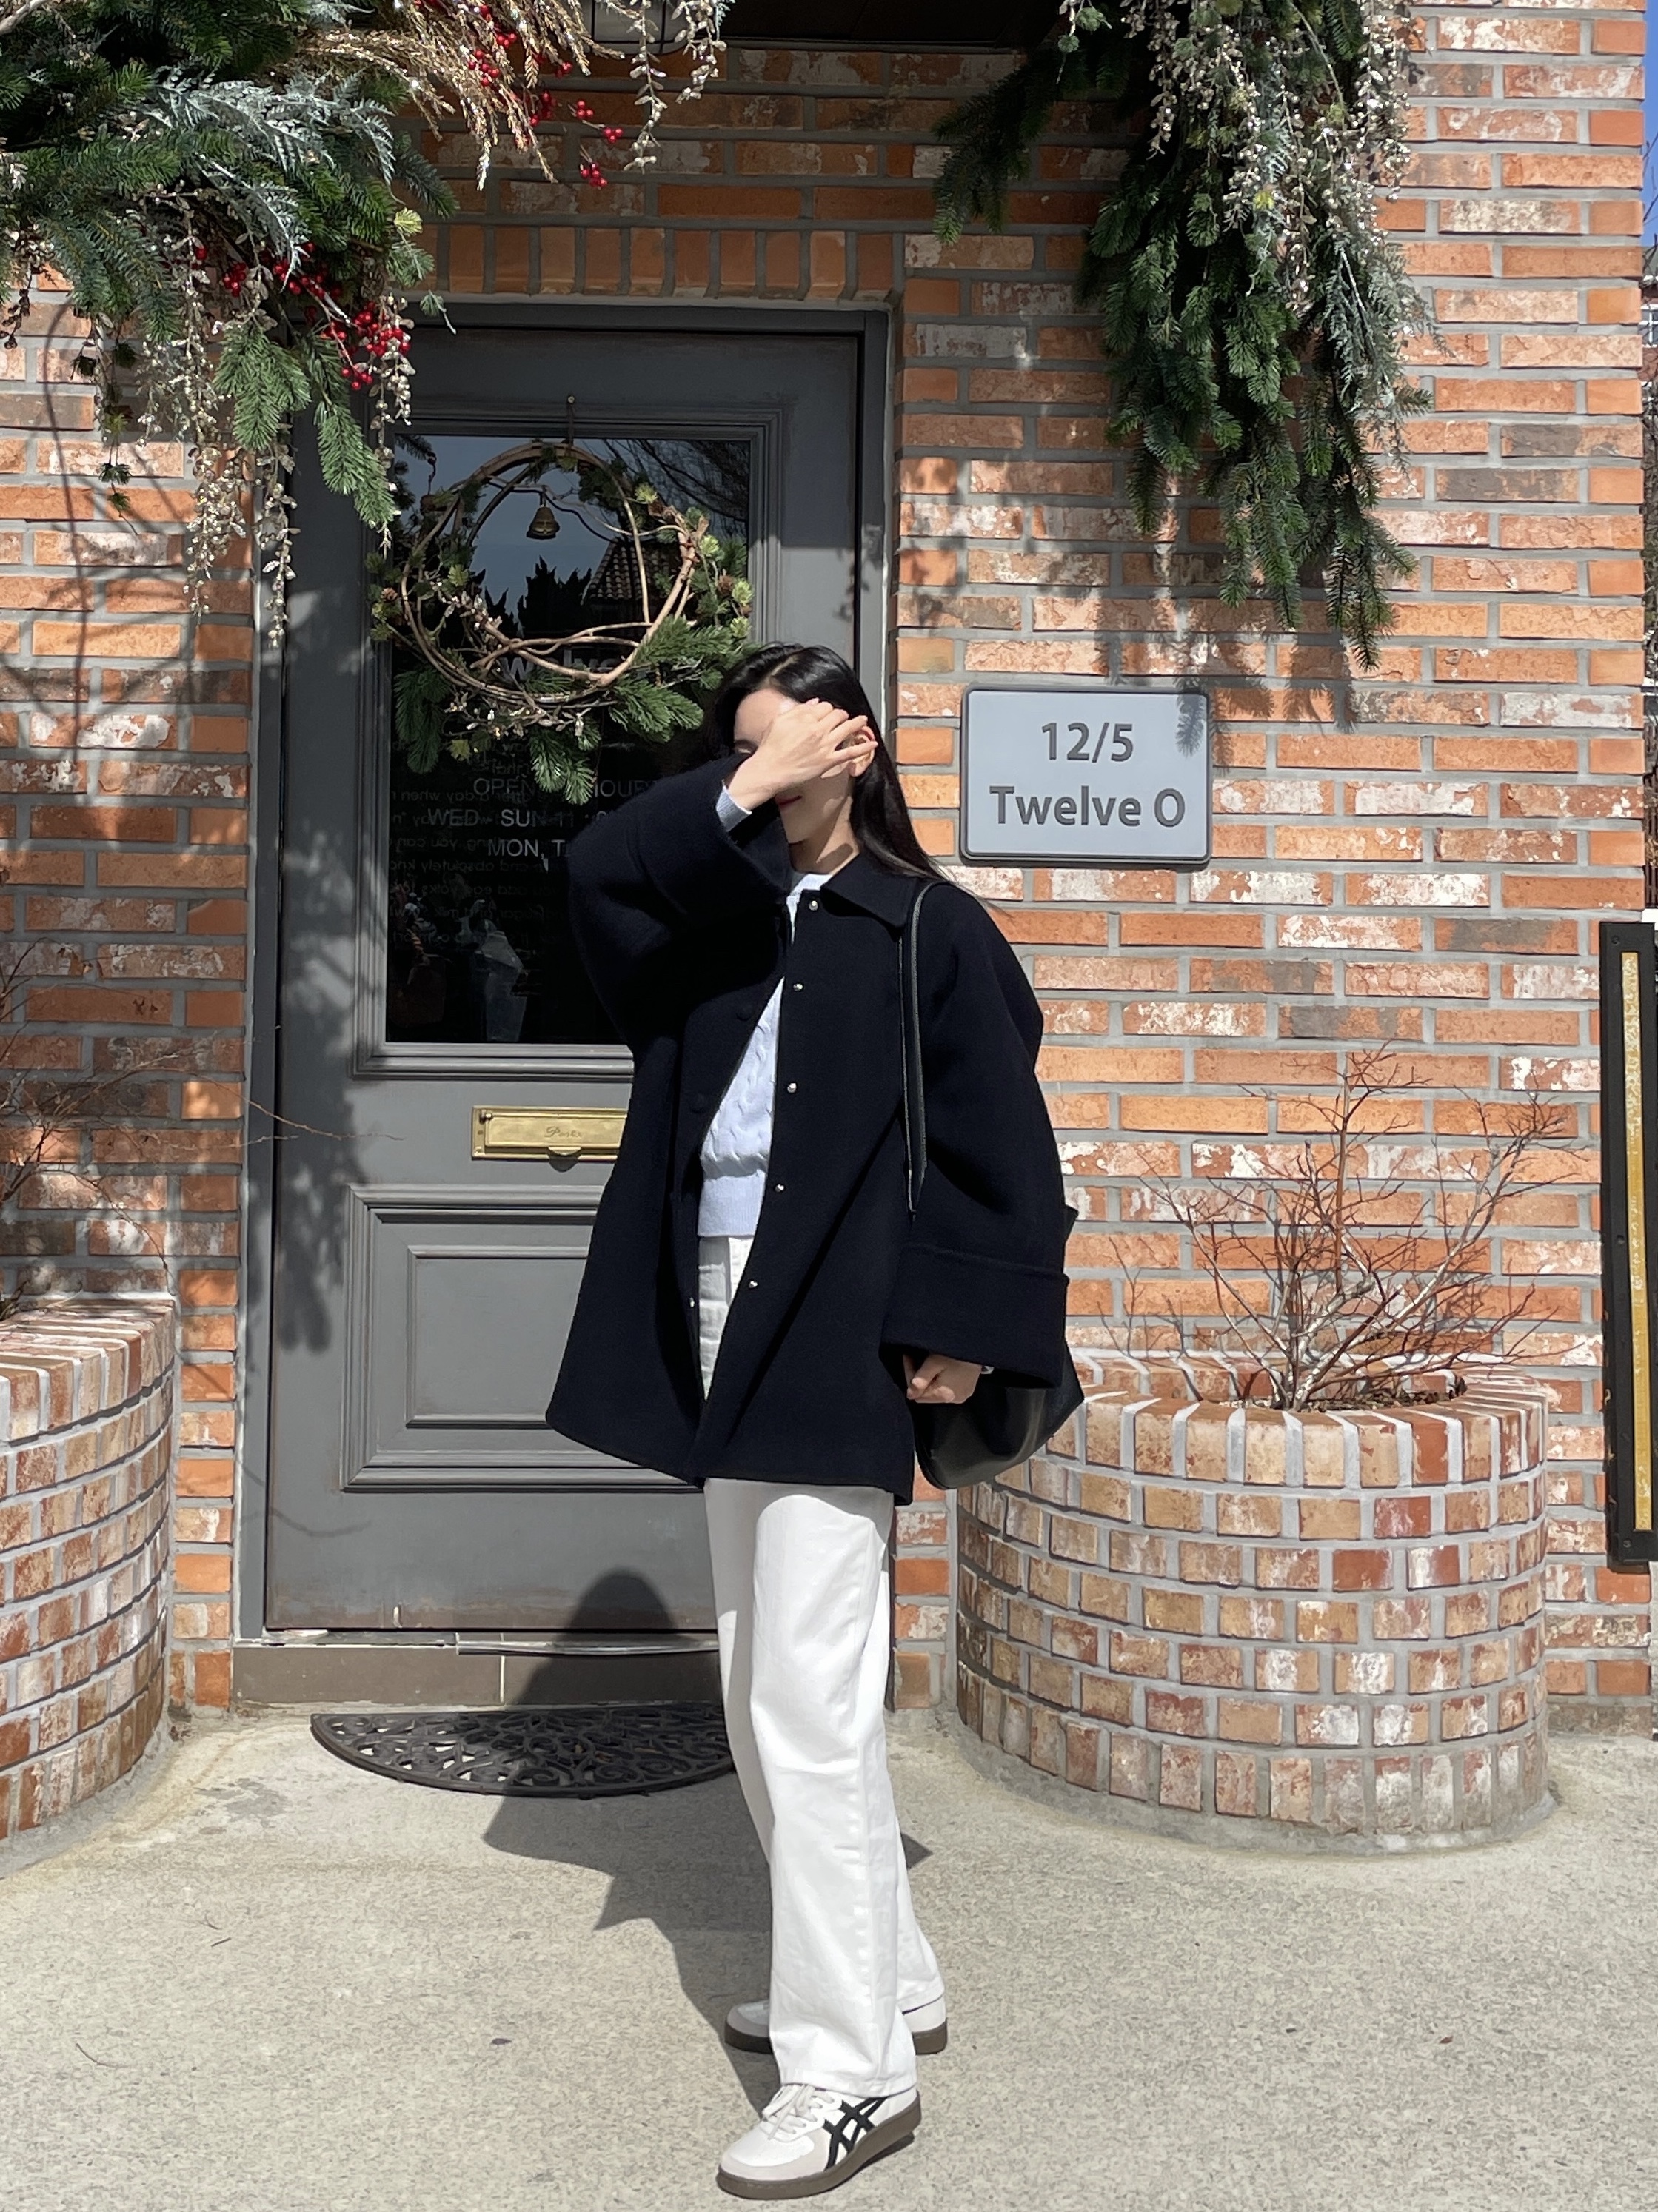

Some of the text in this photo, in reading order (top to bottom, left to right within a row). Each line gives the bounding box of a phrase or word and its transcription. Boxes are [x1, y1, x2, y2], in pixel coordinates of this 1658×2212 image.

[1041, 722, 1134, 763] 12/5
[473, 777, 656, 797] OPEN OUR
[989, 785, 1142, 827] Twelve
[427, 808, 479, 826] WED
[500, 808, 546, 827] SUN
[487, 839, 544, 859] MON,
